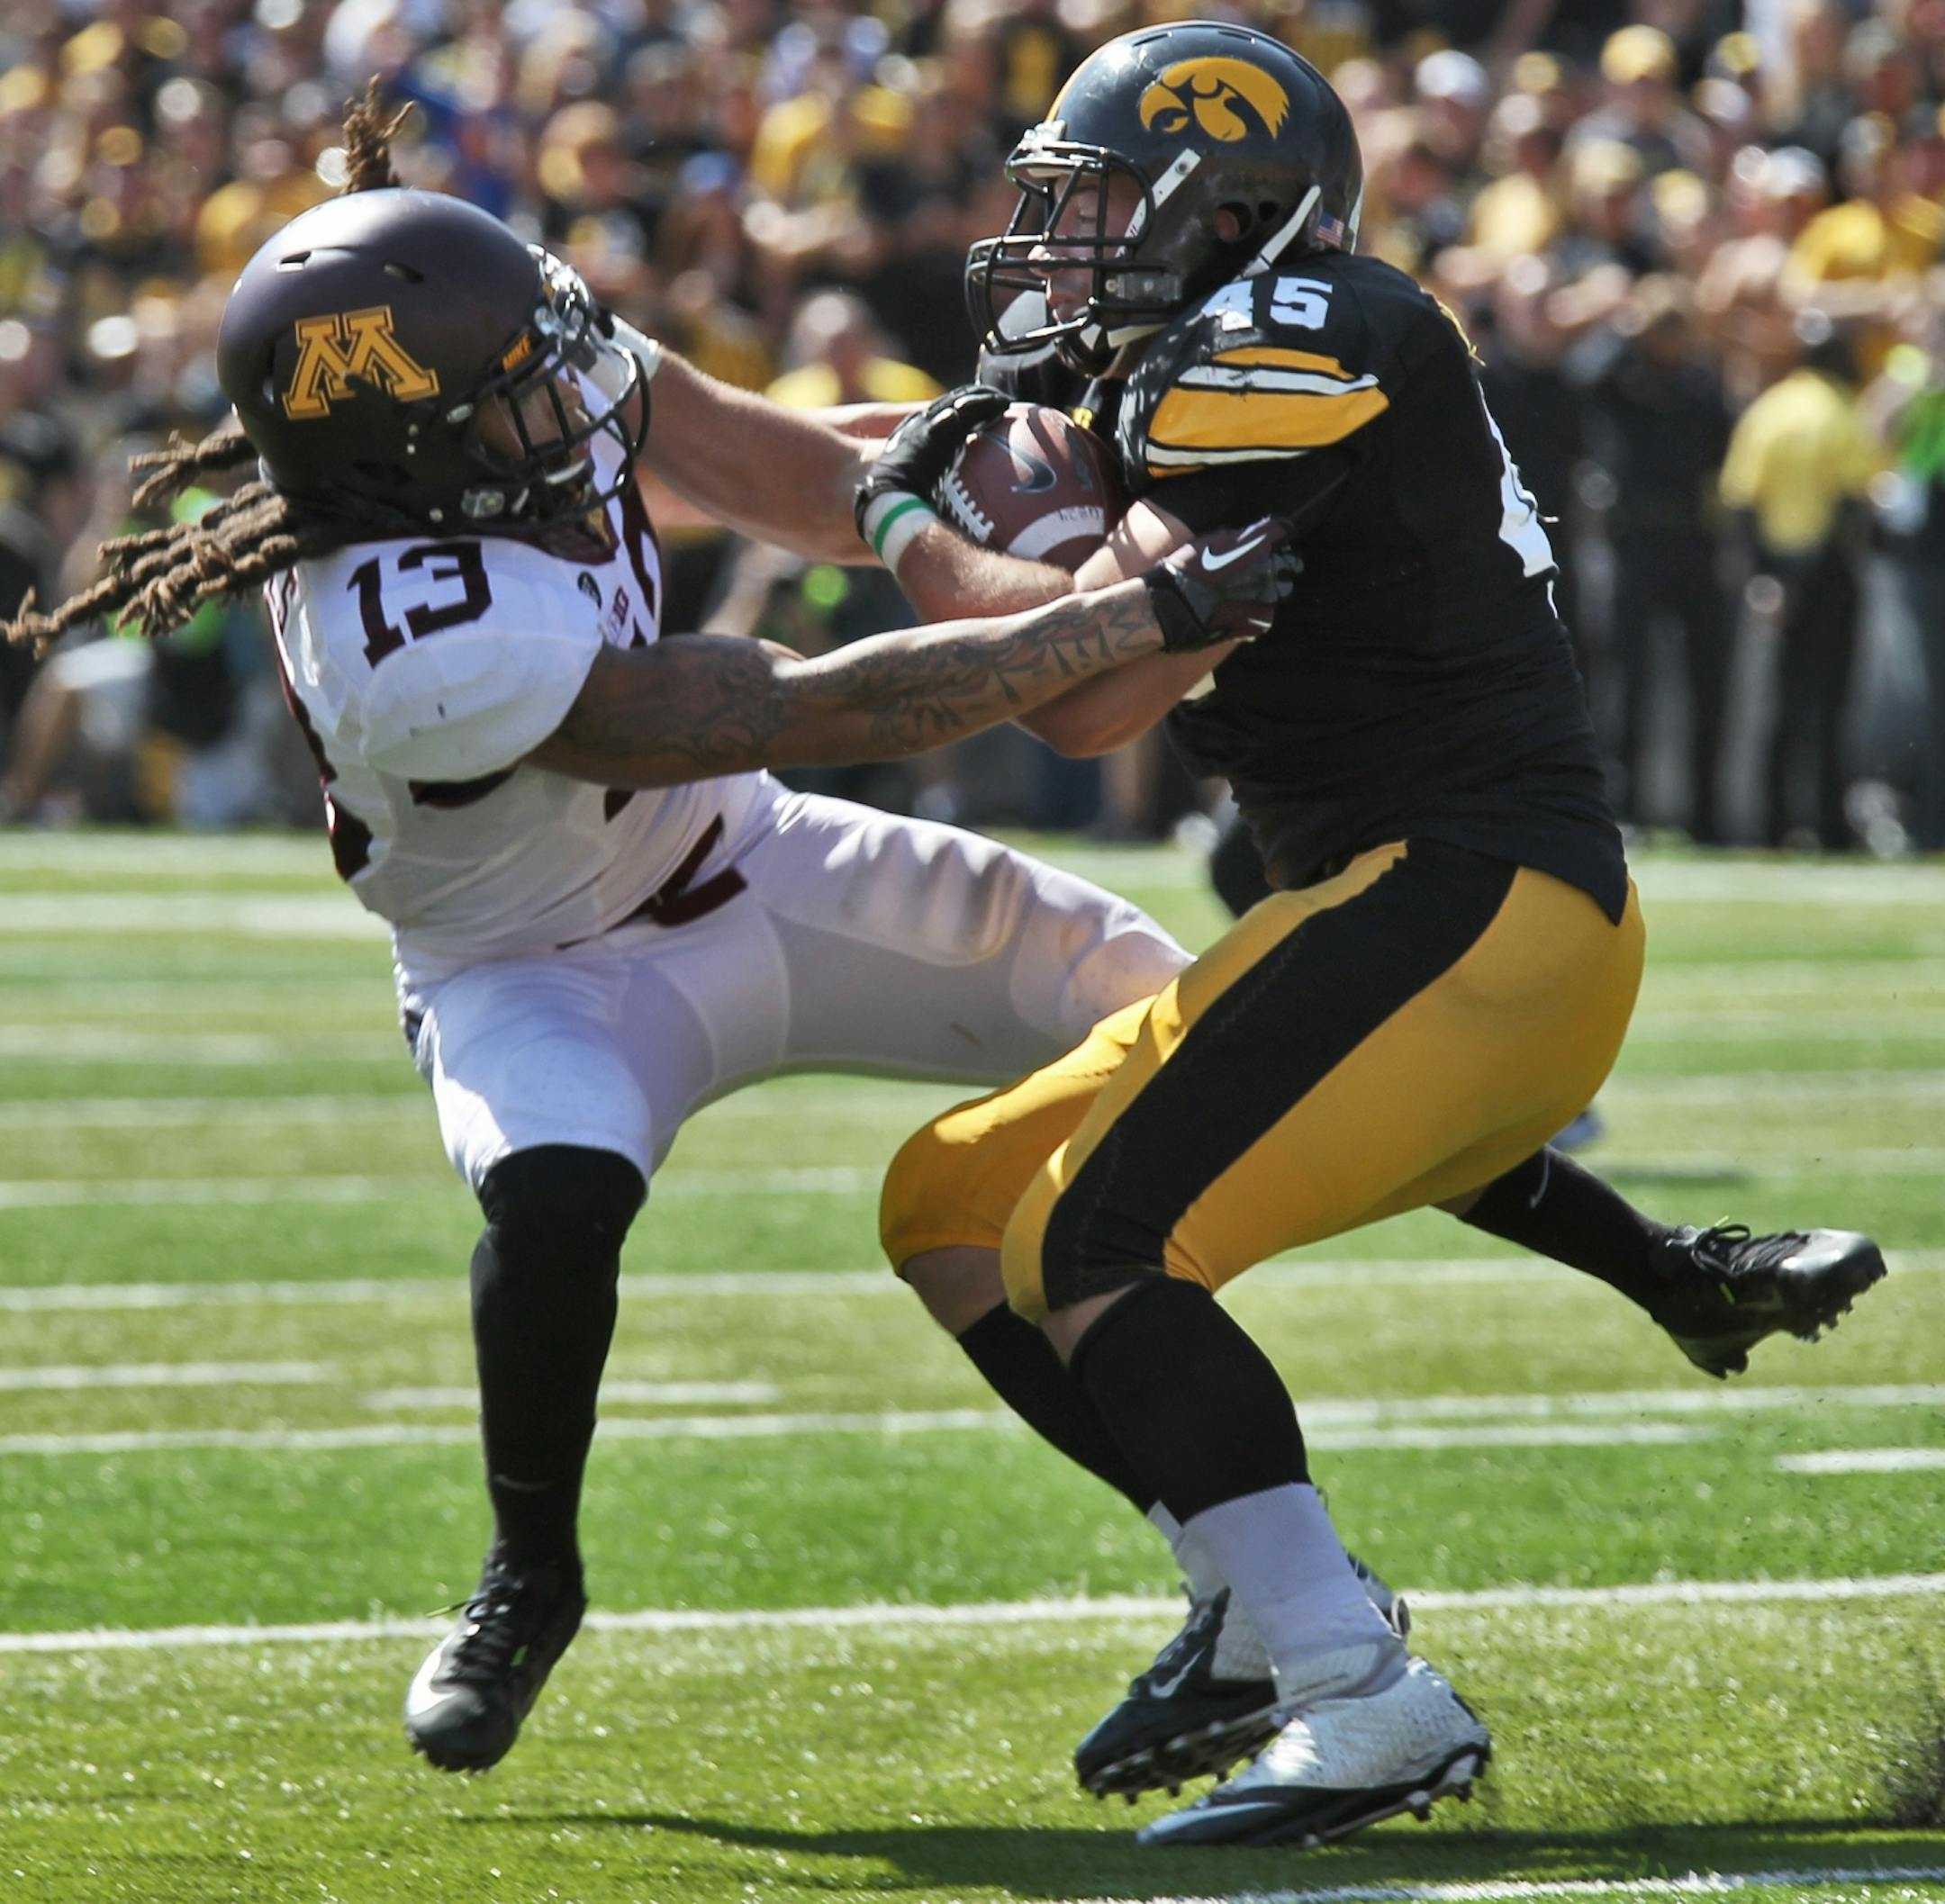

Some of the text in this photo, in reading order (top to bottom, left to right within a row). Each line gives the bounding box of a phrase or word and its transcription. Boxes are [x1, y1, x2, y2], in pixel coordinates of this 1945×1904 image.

[1200, 275, 1334, 332] 45
[282, 304, 439, 420] M
[347, 540, 493, 670] 13
